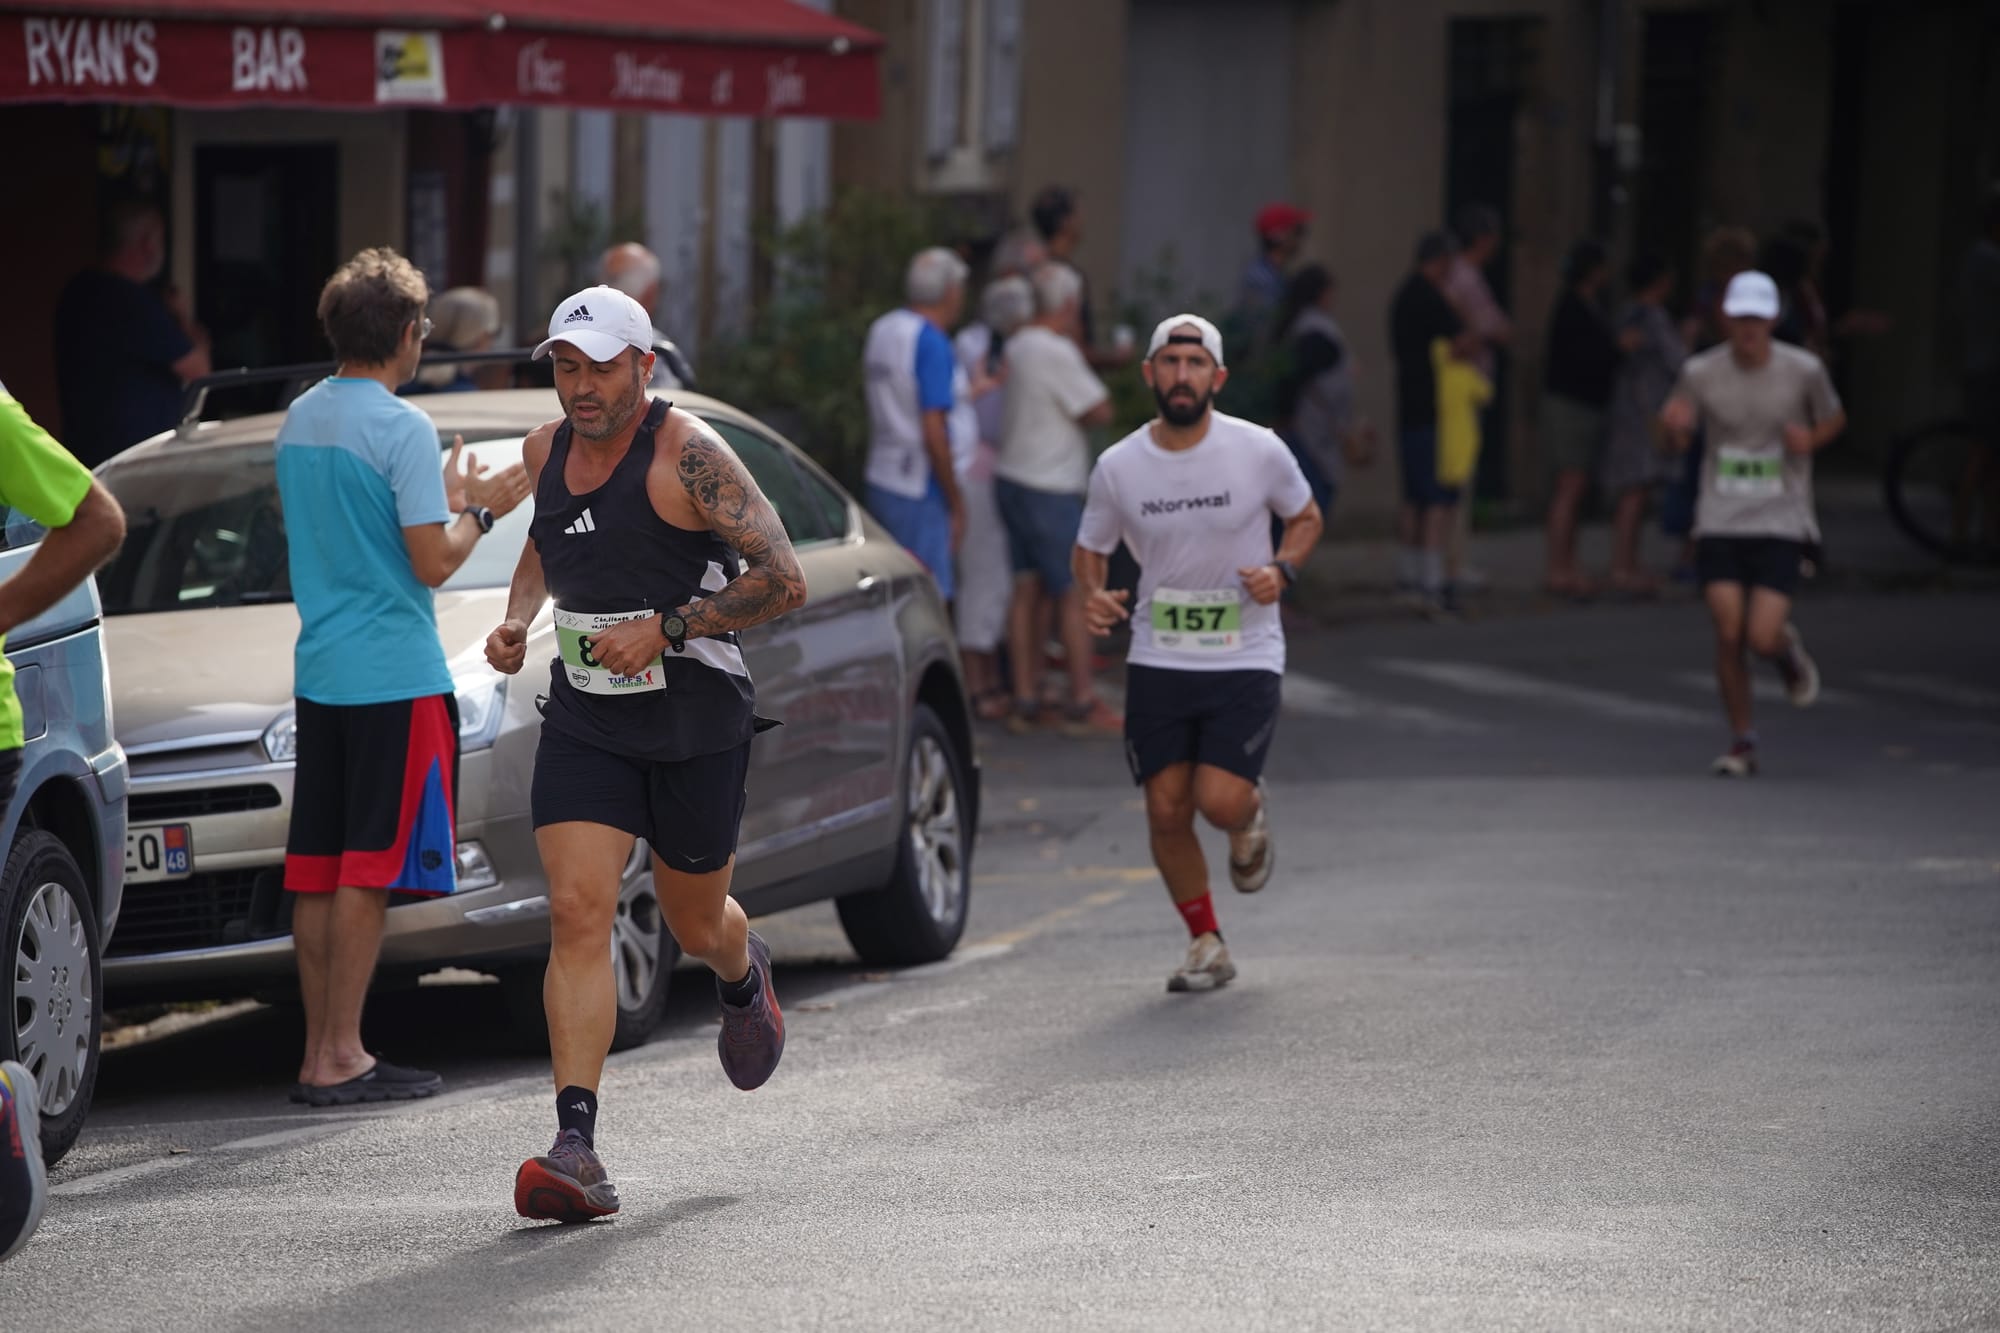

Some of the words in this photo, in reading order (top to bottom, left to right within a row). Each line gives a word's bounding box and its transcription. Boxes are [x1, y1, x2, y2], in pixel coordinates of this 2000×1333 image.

[25, 18, 158, 86] RYAN'S
[232, 28, 307, 90] BAR
[564, 314, 593, 323] adidas
[1163, 606, 1226, 632] 157
[168, 850, 187, 870] 48
